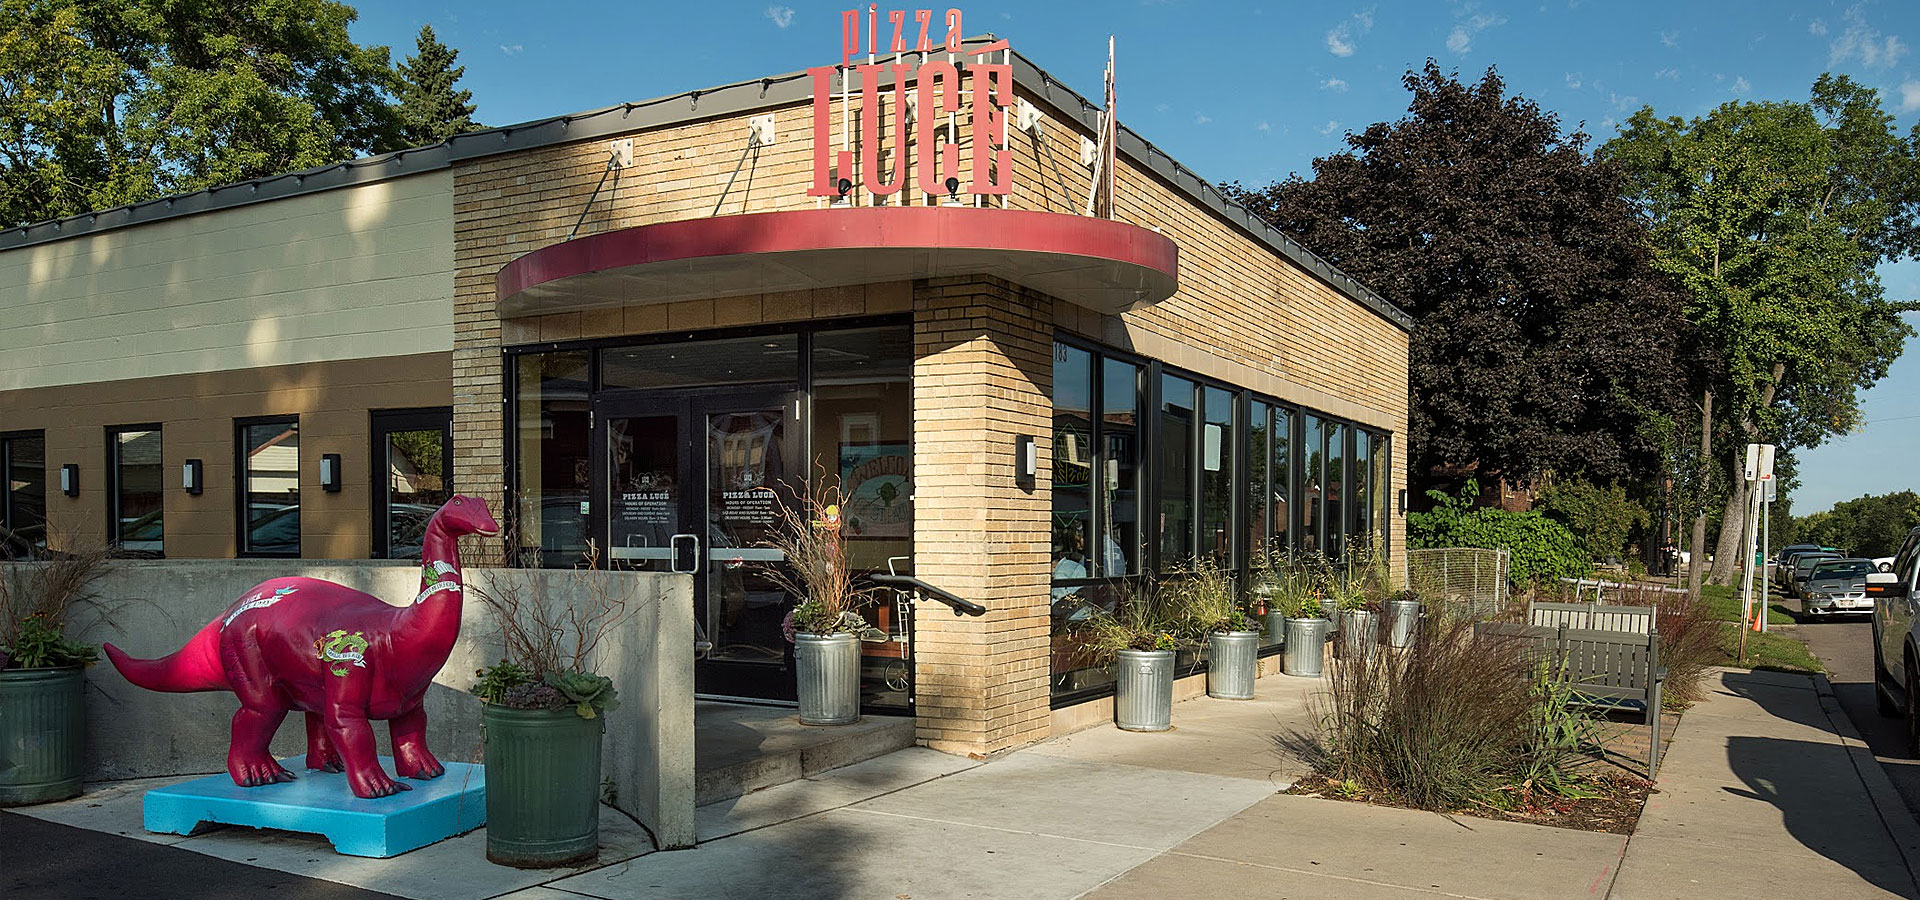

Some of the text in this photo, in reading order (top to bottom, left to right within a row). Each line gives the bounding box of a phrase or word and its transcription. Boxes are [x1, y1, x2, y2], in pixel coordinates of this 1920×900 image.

[841, 3, 963, 68] pizza
[807, 38, 1013, 197] LUCÉ
[649, 490, 670, 500] LUCÉ
[722, 491, 751, 499] PIZZA
